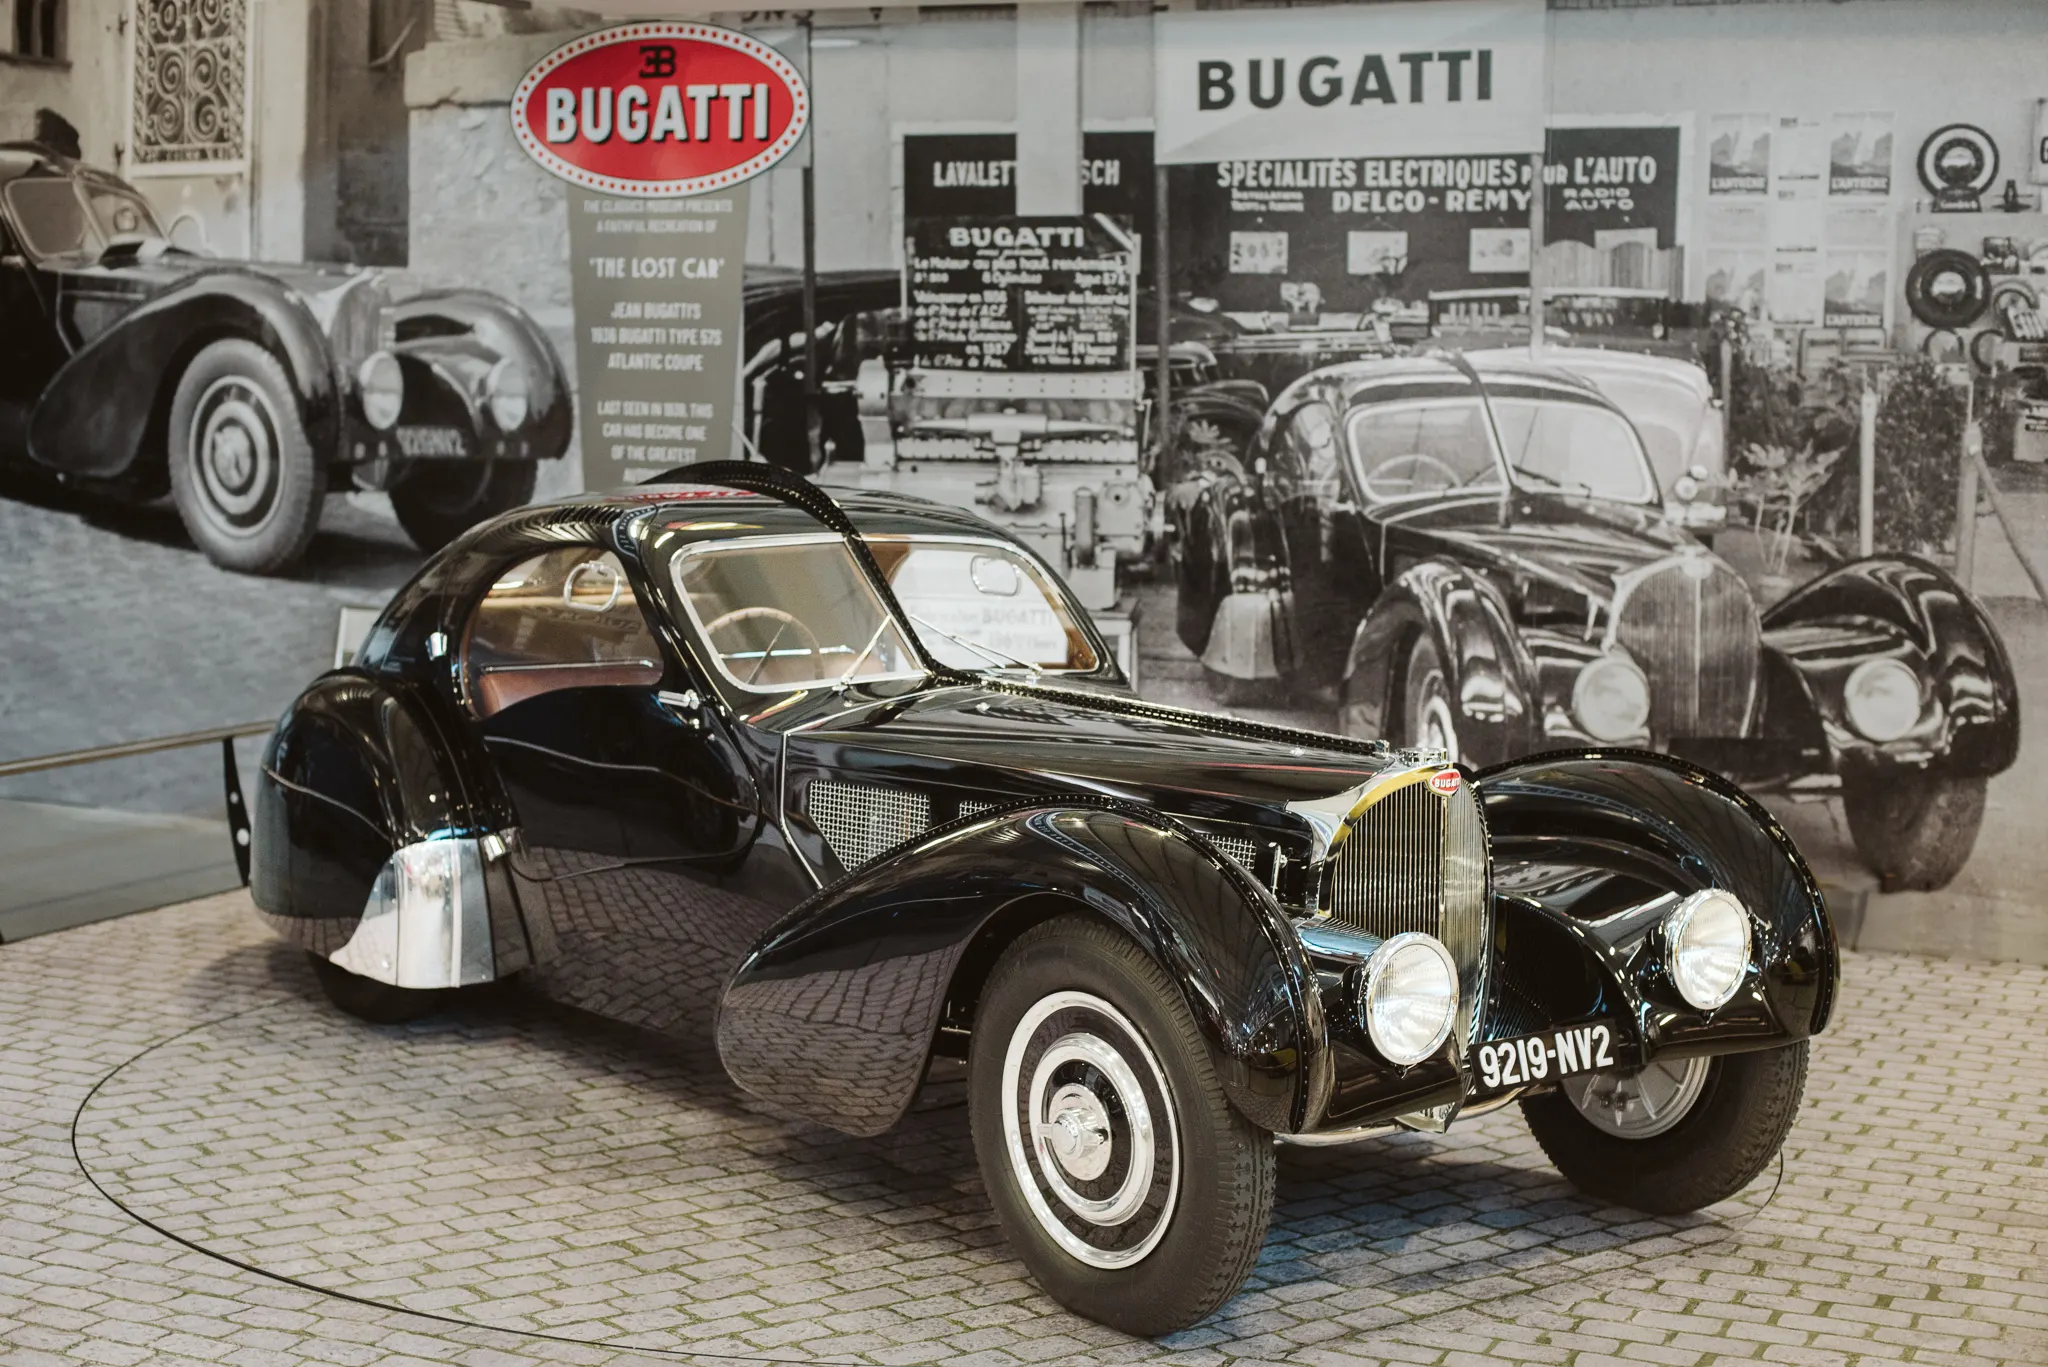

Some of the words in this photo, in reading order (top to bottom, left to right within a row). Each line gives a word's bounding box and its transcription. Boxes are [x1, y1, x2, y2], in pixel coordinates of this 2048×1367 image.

[1198, 49, 1492, 112] BUGATTI
[546, 83, 771, 144] BUGATTI
[1521, 163, 1569, 186] PUR
[1574, 155, 1657, 185] L'AUTO
[1563, 187, 1631, 199] RADIO
[1564, 198, 1635, 211] AUTO
[949, 226, 1085, 248] BUGATTI
[631, 257, 677, 279] LOST
[668, 327, 698, 346] TYPE
[607, 352, 663, 370] ATLANTIC
[1479, 1025, 1614, 1088] 9219-NV2
